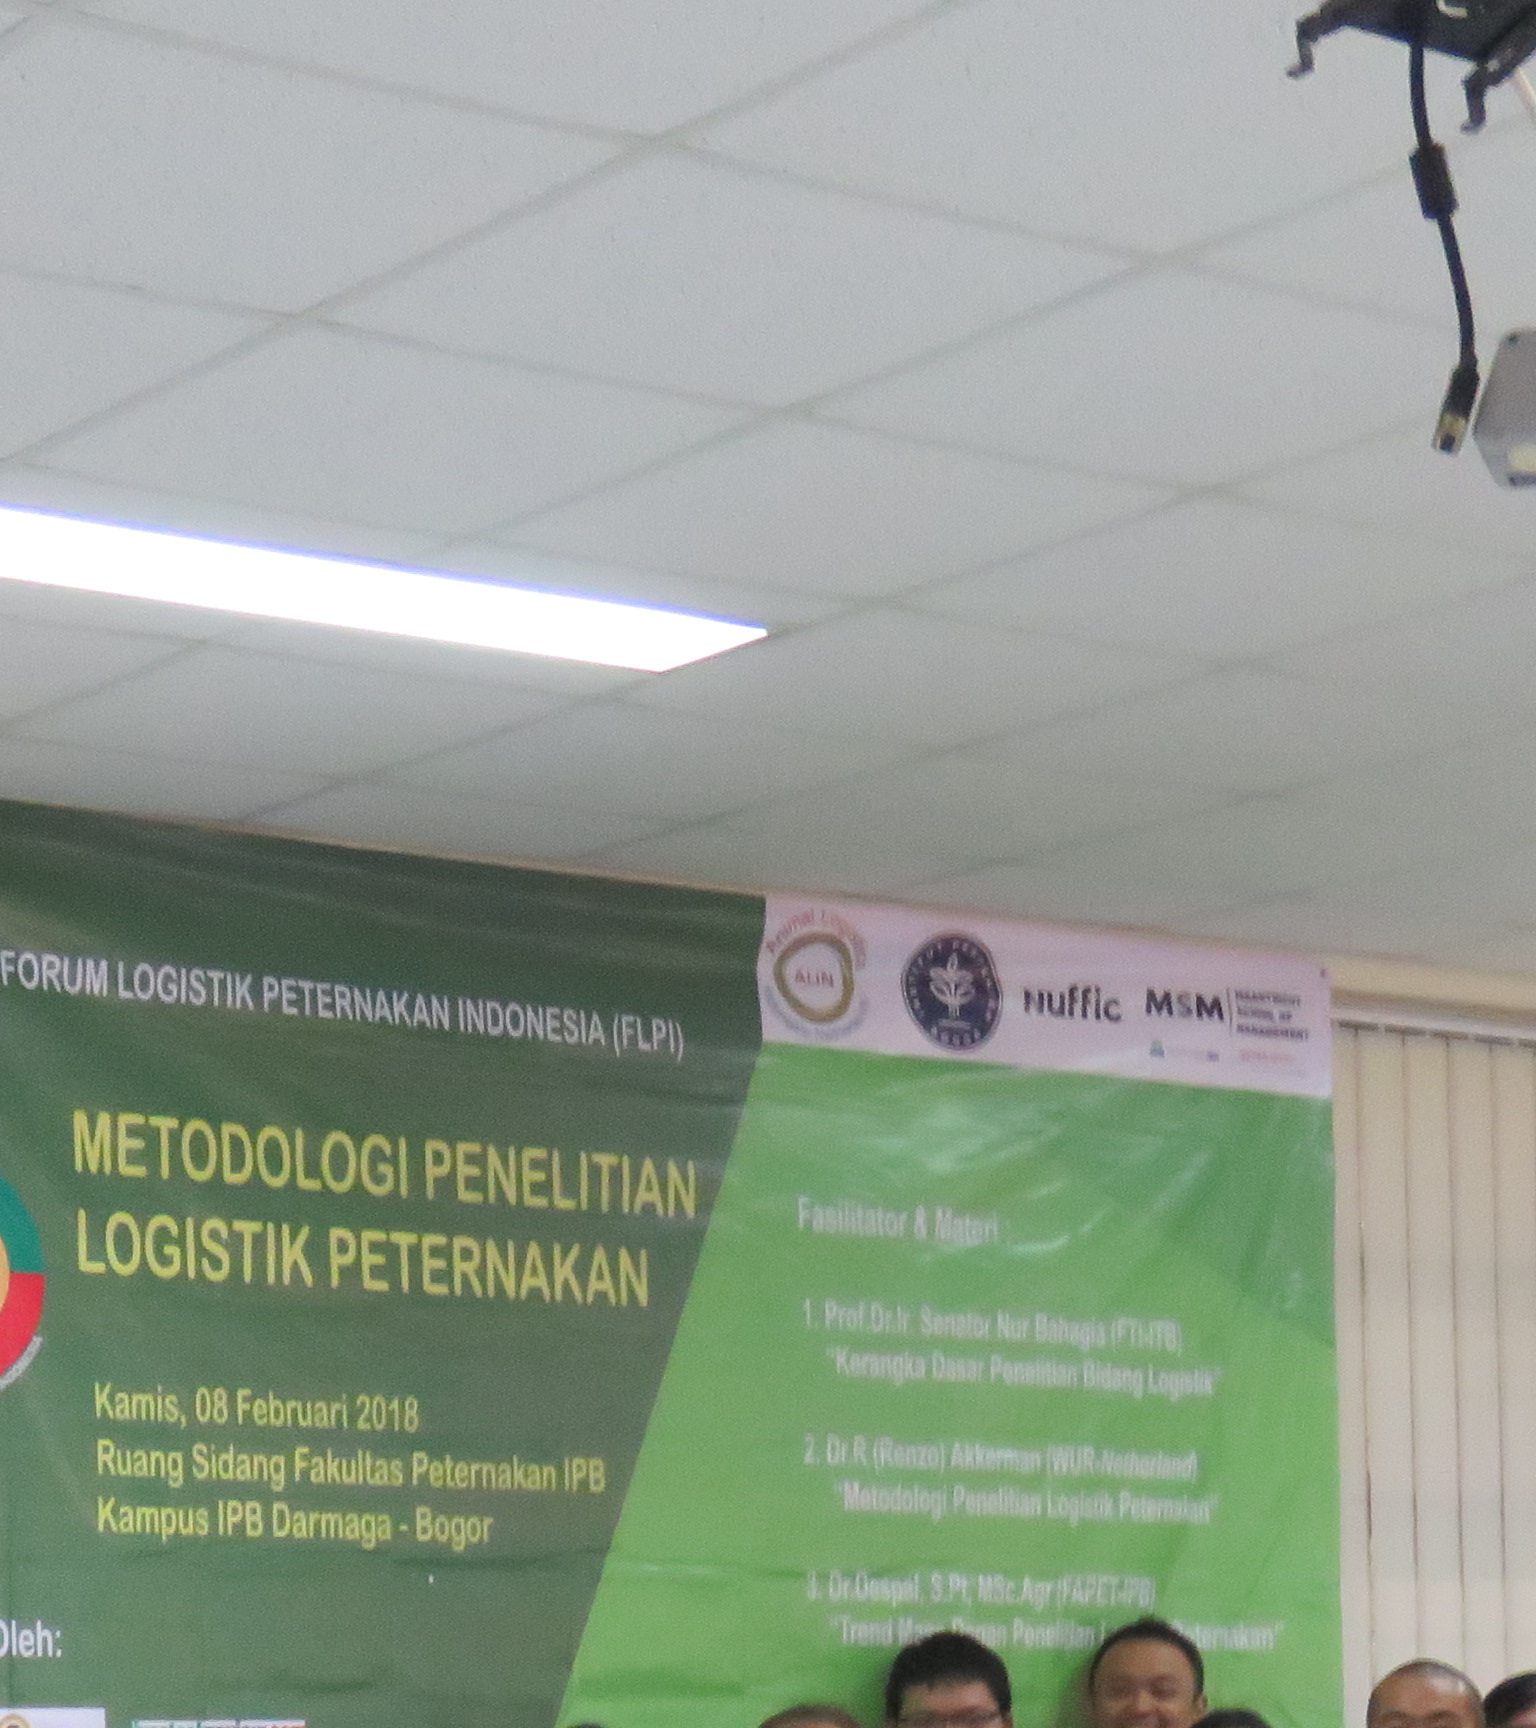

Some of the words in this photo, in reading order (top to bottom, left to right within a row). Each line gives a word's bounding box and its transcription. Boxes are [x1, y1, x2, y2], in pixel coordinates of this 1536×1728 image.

[0, 950, 109, 998] FORUM
[117, 960, 255, 1011] LOGISTIK
[263, 976, 451, 1032] PETERNAKAN
[458, 996, 607, 1047] INDONESIA
[612, 1013, 685, 1062] (FLPI)
[1145, 986, 1225, 1022] MSM
[72, 1109, 408, 1199] METODOLOGI
[424, 1139, 697, 1219] PENELITIAN
[77, 1208, 314, 1288] LOGISTIK
[329, 1227, 649, 1307] PETERNAKAN
[94, 1382, 187, 1428] Kamis,
[195, 1387, 230, 1424] 08
[235, 1388, 348, 1430] Februari
[356, 1394, 420, 1433] 2018
[96, 1438, 183, 1487] Ruang
[192, 1443, 285, 1491] Sidang
[293, 1446, 404, 1487] Fakultas
[412, 1451, 556, 1492] Peternakan
[564, 1456, 607, 1494] IPB
[96, 1496, 209, 1541] Kampus
[217, 1499, 263, 1538] IPB
[271, 1502, 393, 1550] Darmaga
[416, 1506, 494, 1552] Bogor
